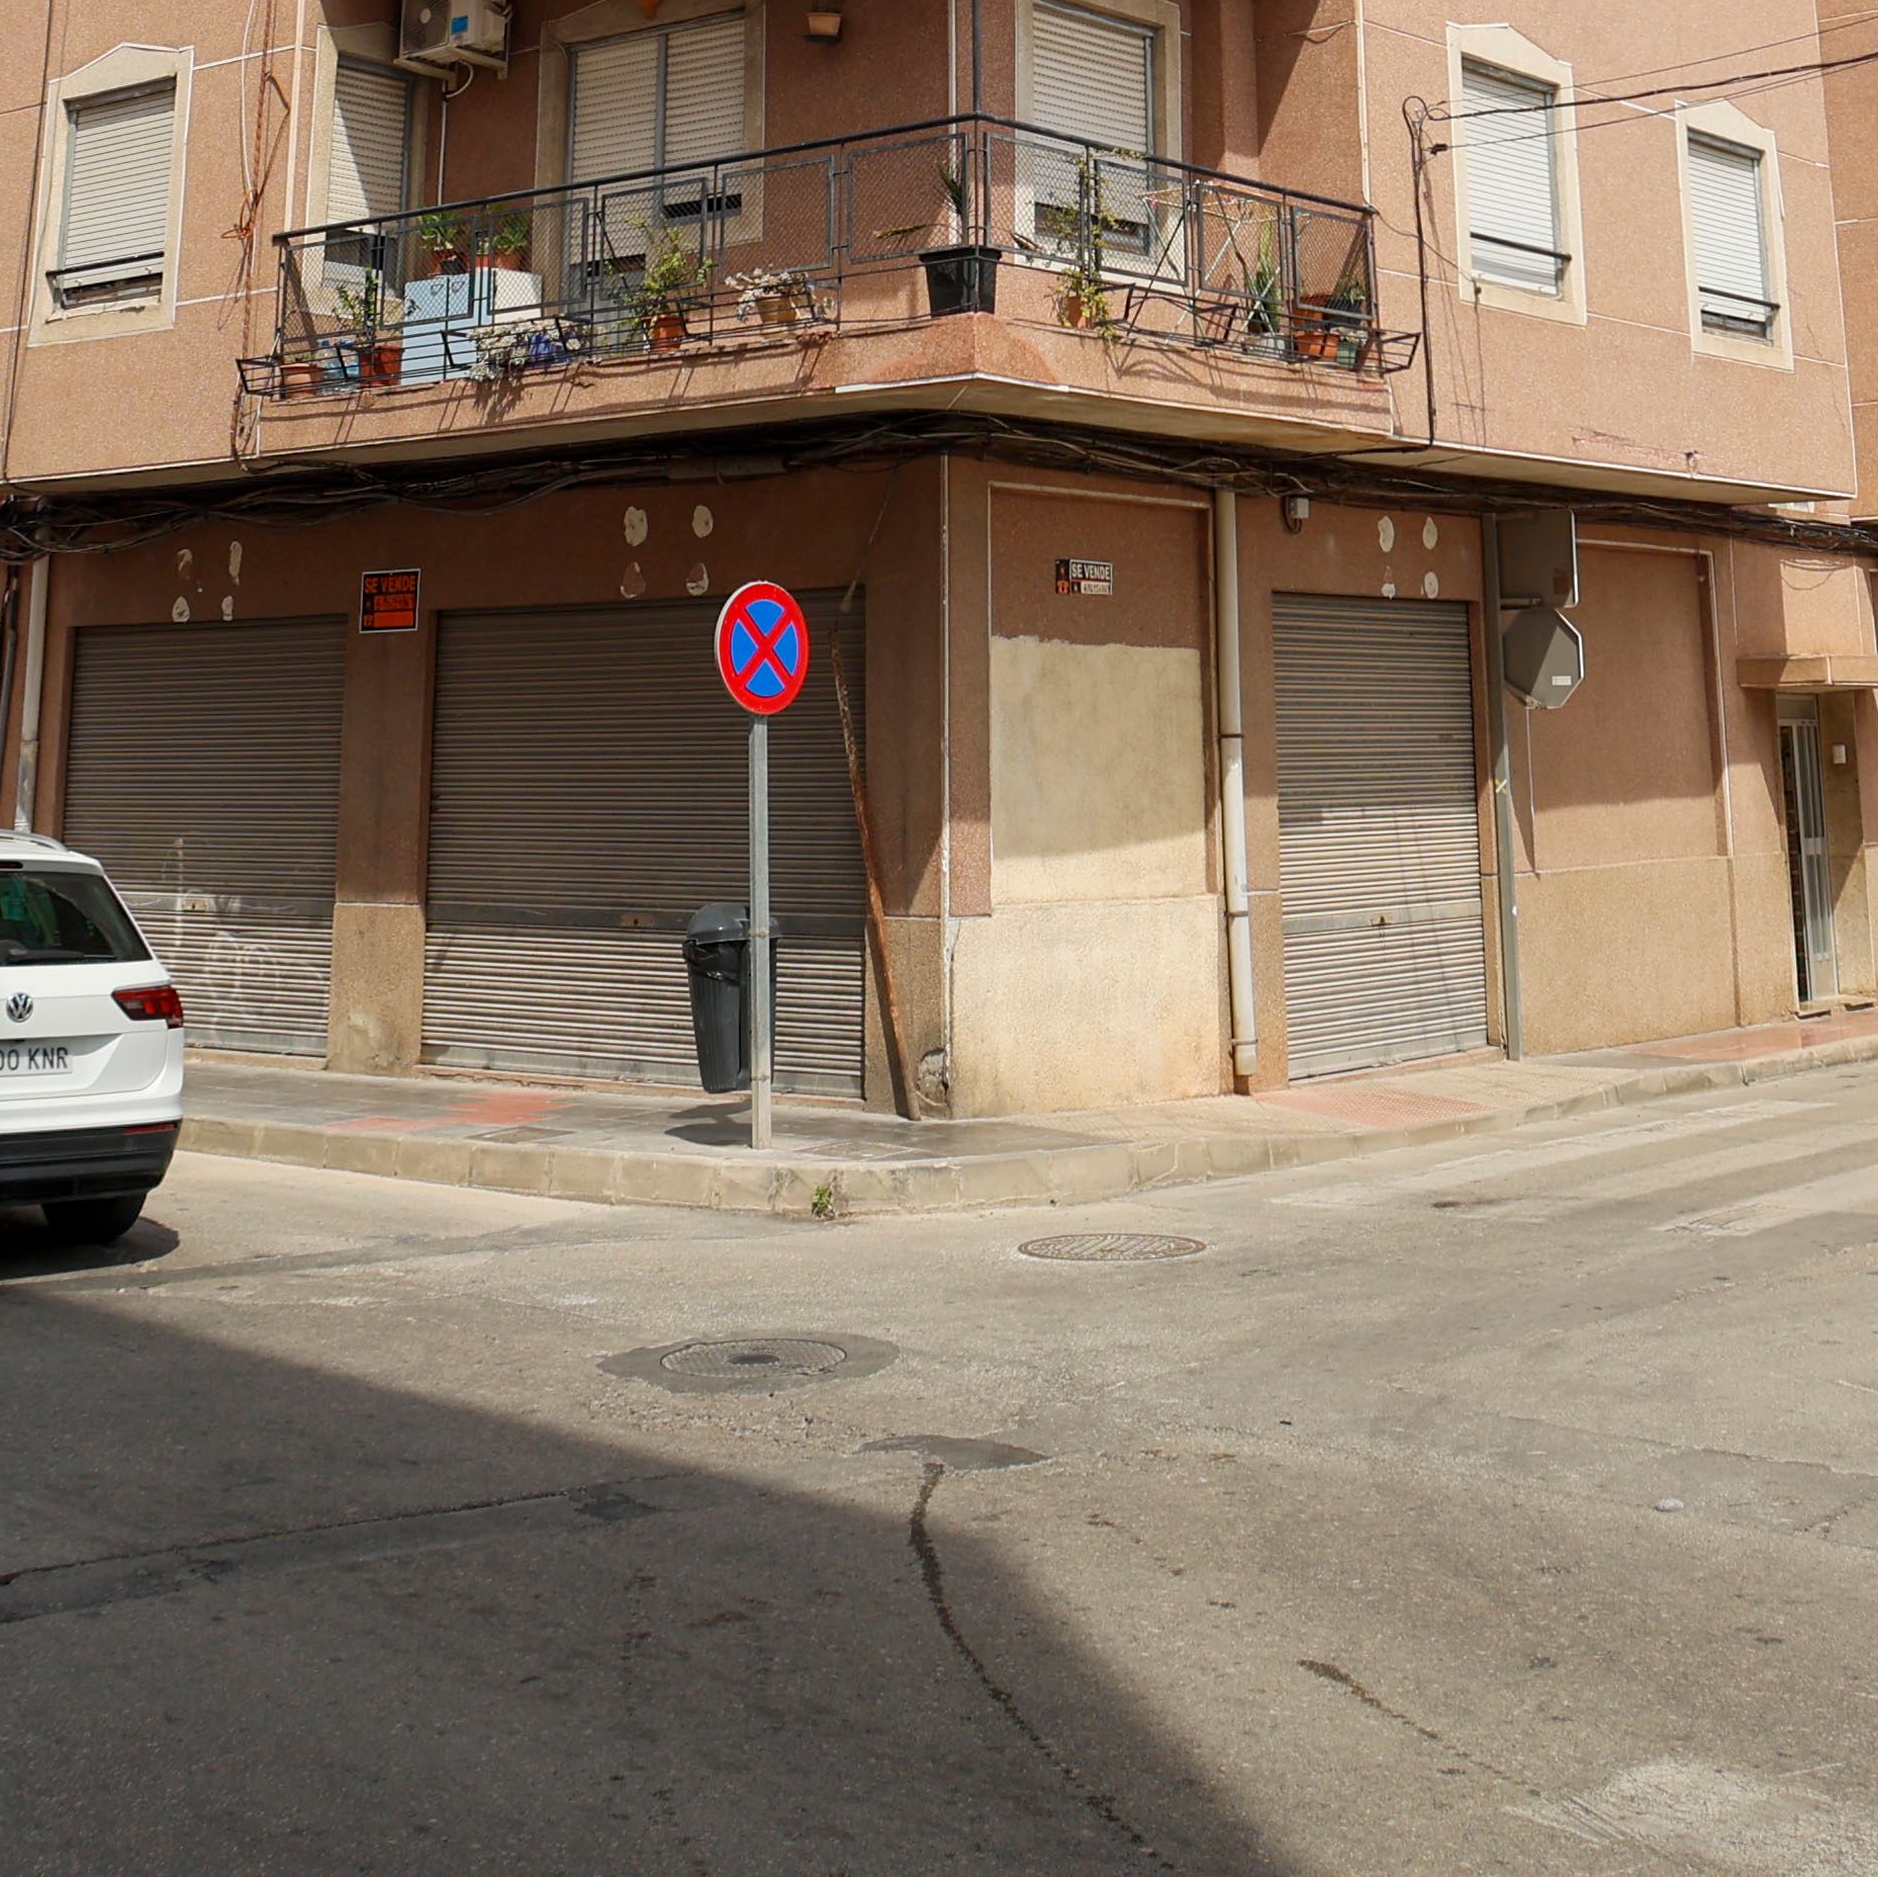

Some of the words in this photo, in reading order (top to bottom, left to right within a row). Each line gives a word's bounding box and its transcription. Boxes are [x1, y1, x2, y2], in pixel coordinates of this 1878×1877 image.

[1071, 563, 1083, 578] SE
[1084, 564, 1110, 580] VENDE
[364, 577, 379, 593] SE
[380, 575, 416, 592] VENDE
[28, 1046, 68, 1070] KNR
